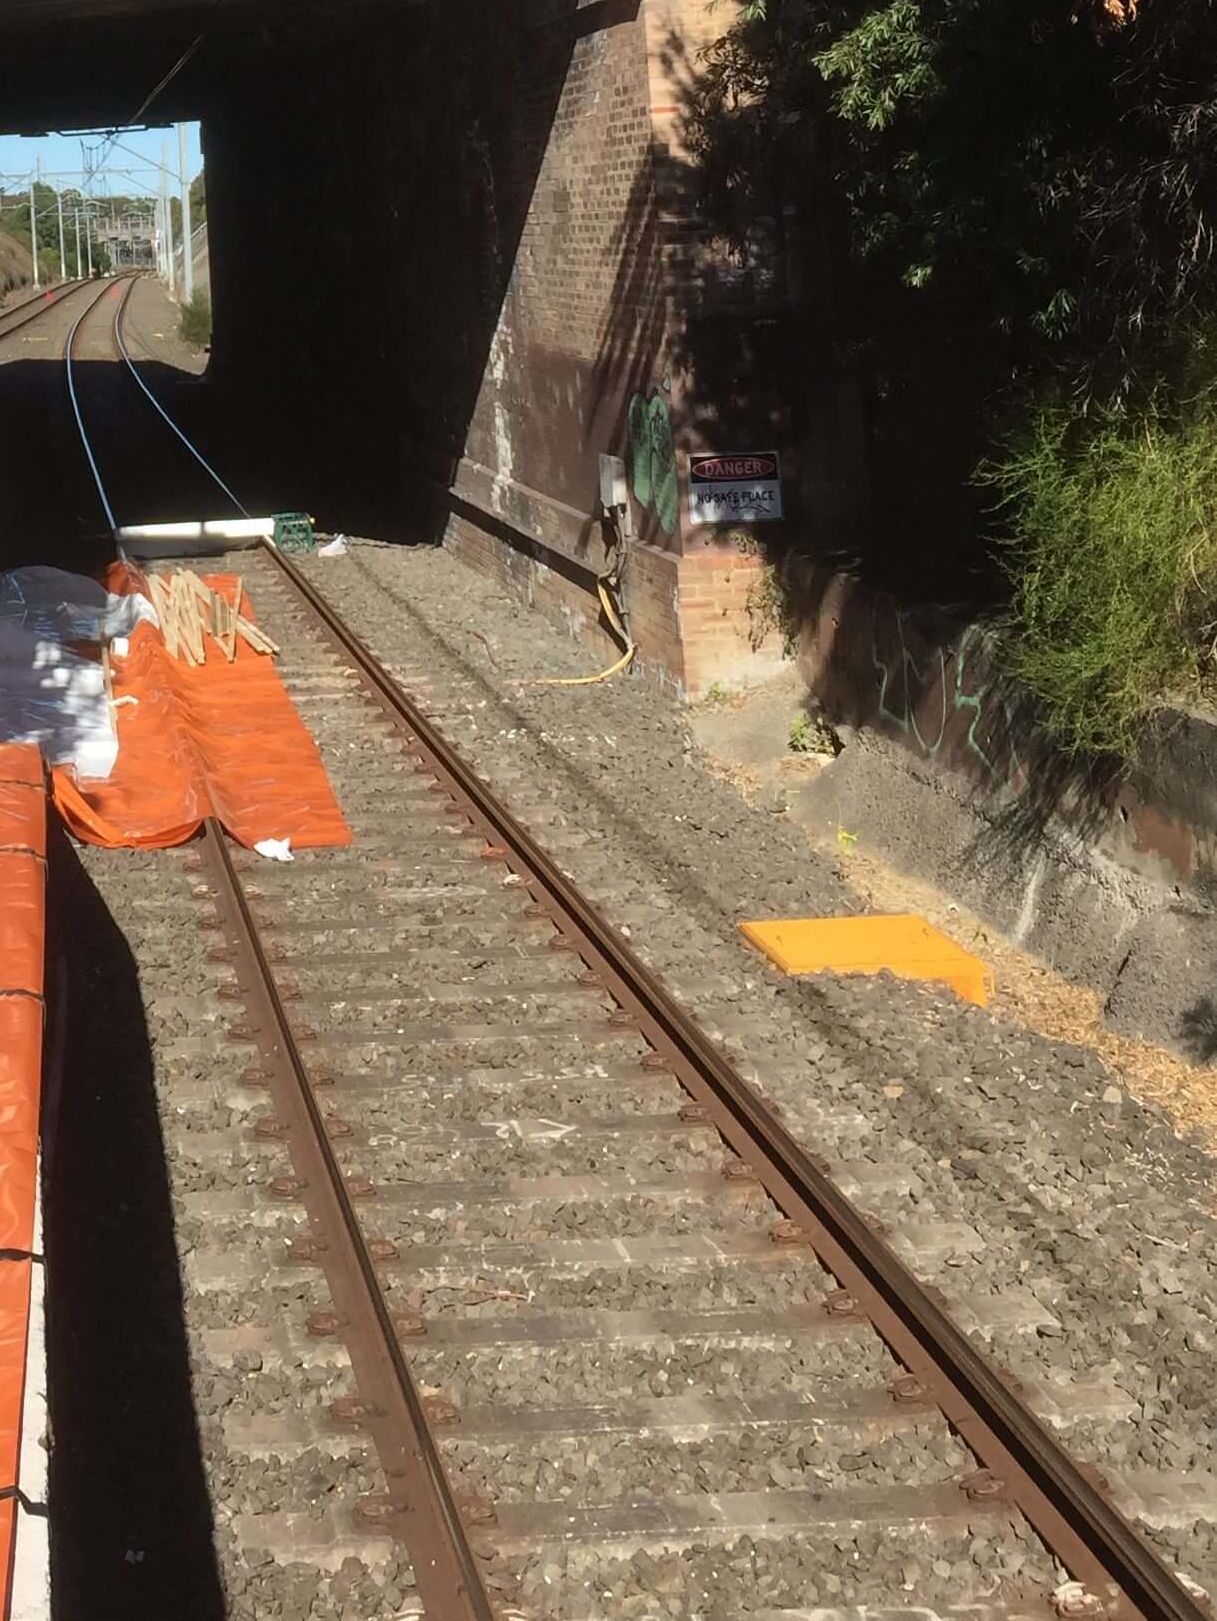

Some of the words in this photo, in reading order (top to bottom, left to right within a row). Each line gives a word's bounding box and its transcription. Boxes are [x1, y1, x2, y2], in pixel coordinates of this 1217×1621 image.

[703, 461, 762, 476] DANGER
[697, 491, 711, 504] NO
[712, 490, 739, 503] SAFE
[741, 490, 775, 502] PLACE
